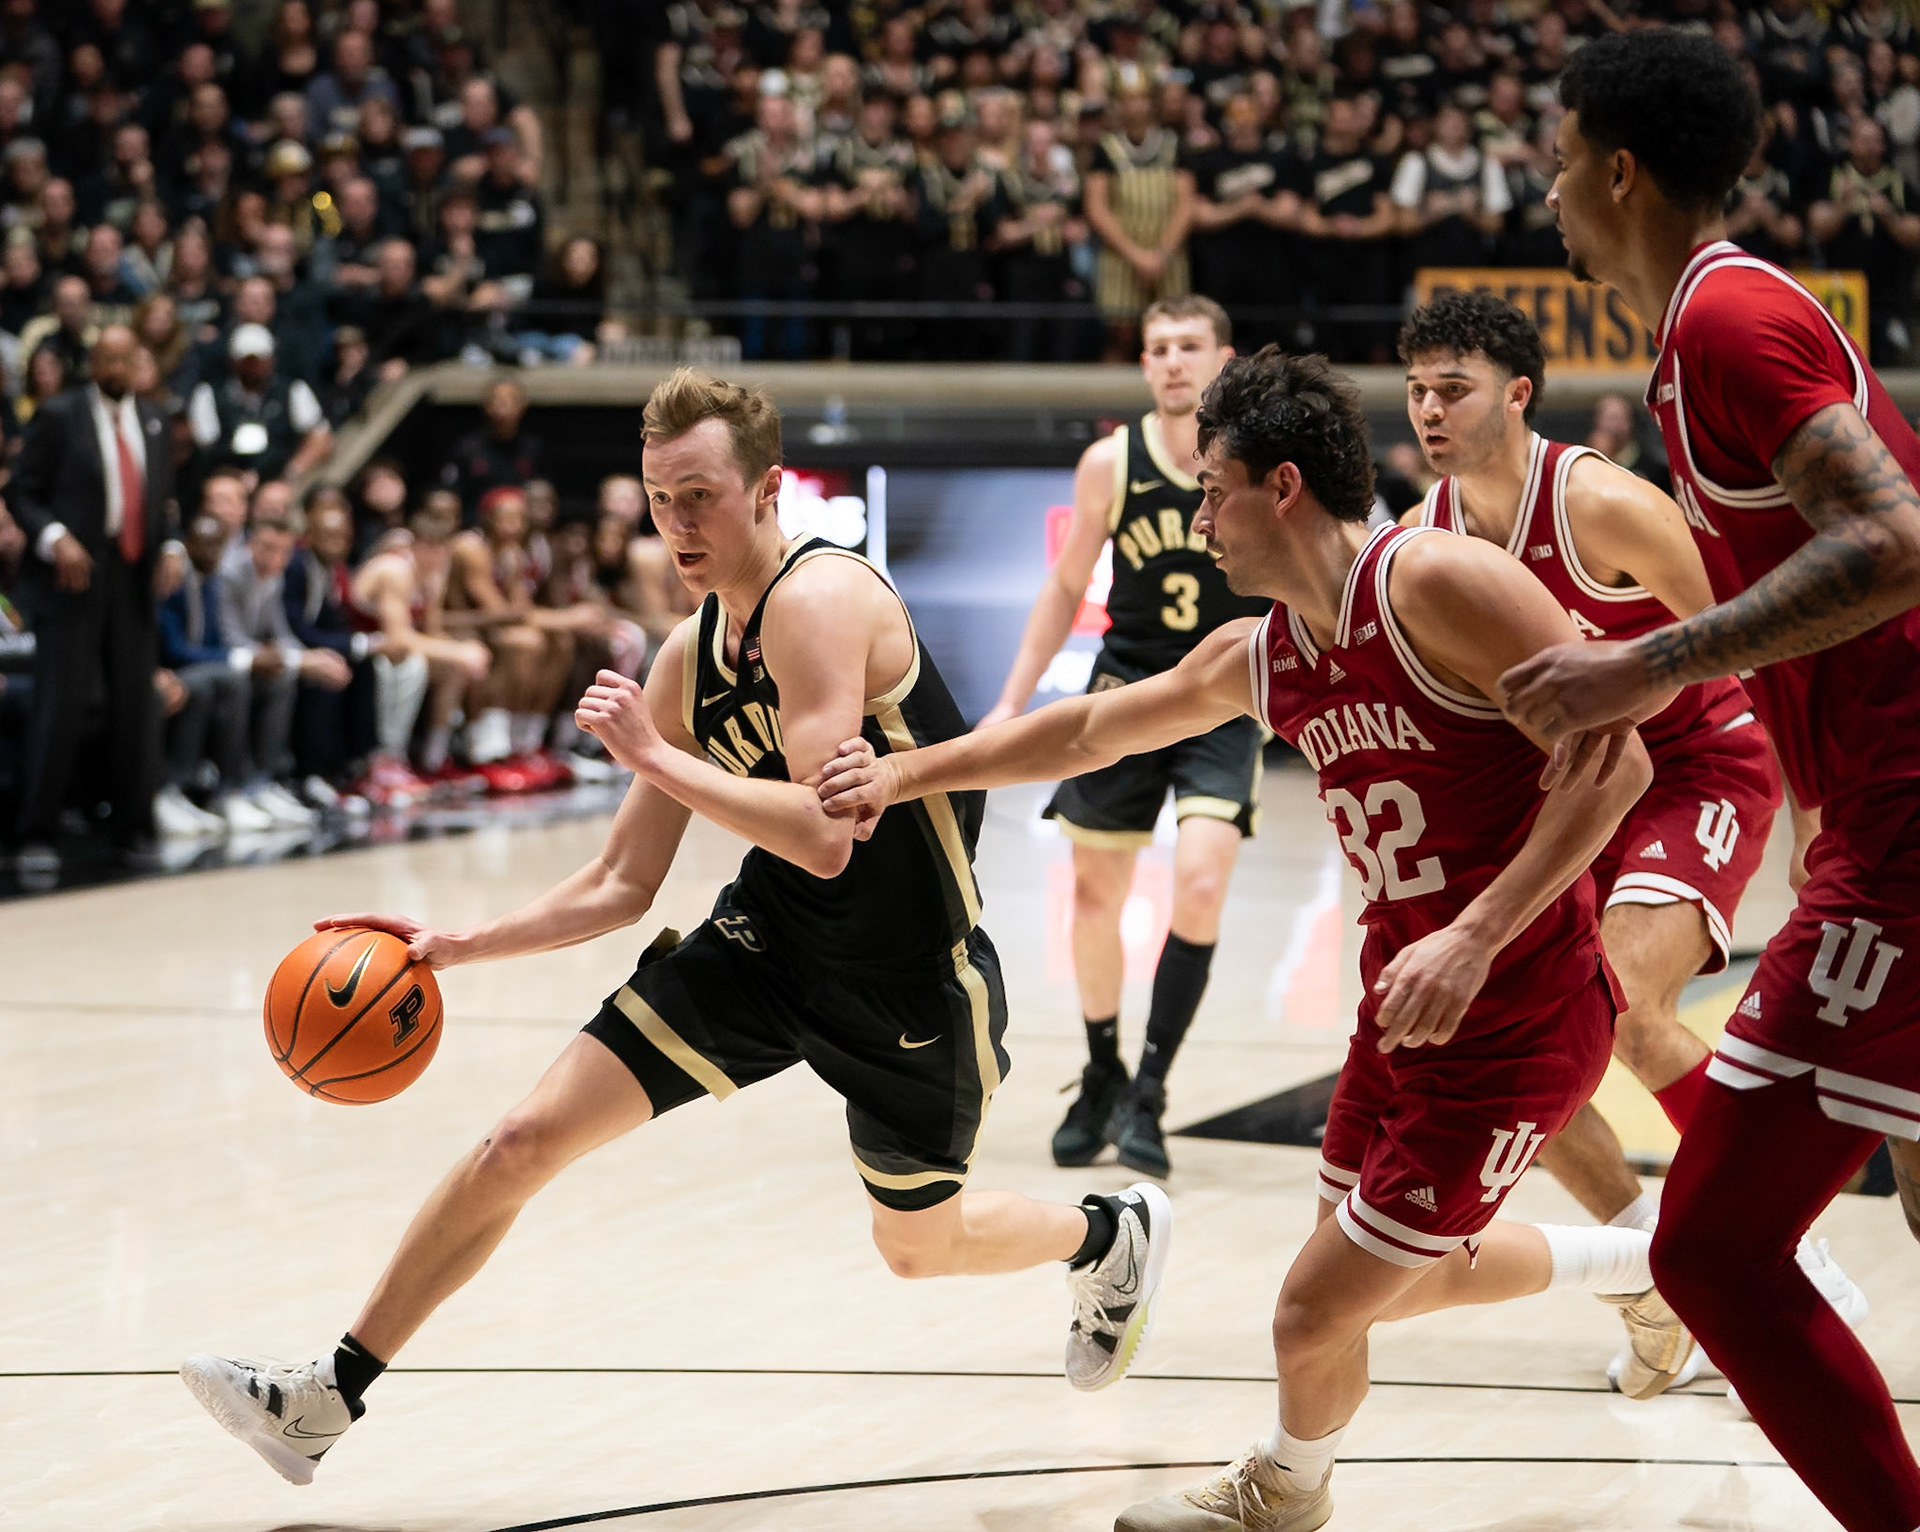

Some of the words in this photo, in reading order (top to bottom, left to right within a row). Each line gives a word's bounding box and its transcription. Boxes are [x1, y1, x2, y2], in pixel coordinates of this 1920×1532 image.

[1161, 572, 1200, 632] 3
[1272, 655, 1298, 673] RMK
[1298, 702, 1436, 772] NDIANA
[1326, 779, 1447, 901] 32
[388, 983, 426, 1048] P
[1405, 1191, 1438, 1213] adidas
